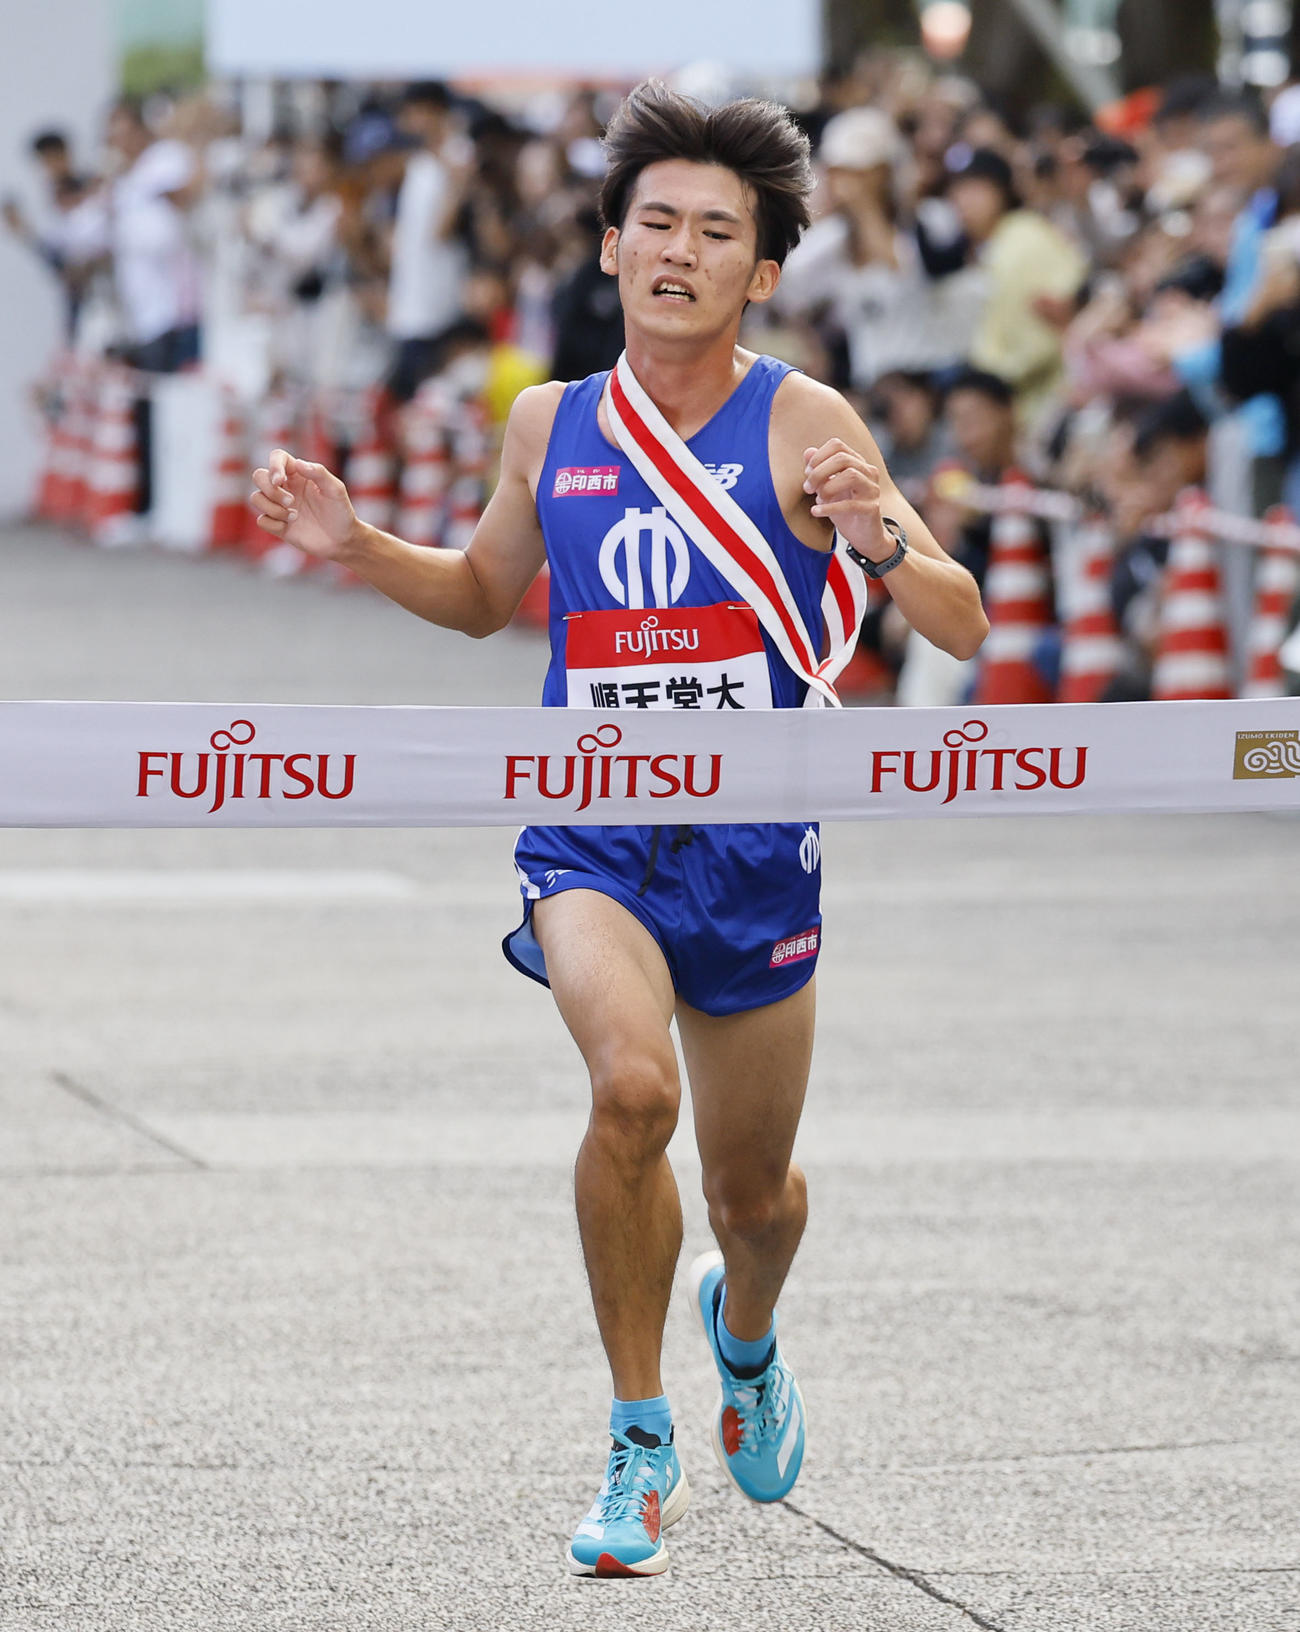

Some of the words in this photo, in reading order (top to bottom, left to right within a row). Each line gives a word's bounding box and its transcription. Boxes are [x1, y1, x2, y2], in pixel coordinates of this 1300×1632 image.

[571, 473, 618, 491] 印西市
[615, 615, 700, 659] FUJITSU
[590, 673, 746, 710] 順天堂大
[136, 719, 356, 813] FUJITSU
[505, 723, 723, 811] FUJITSU
[870, 719, 1088, 804] FUJITSU
[785, 934, 818, 958] 印西市
